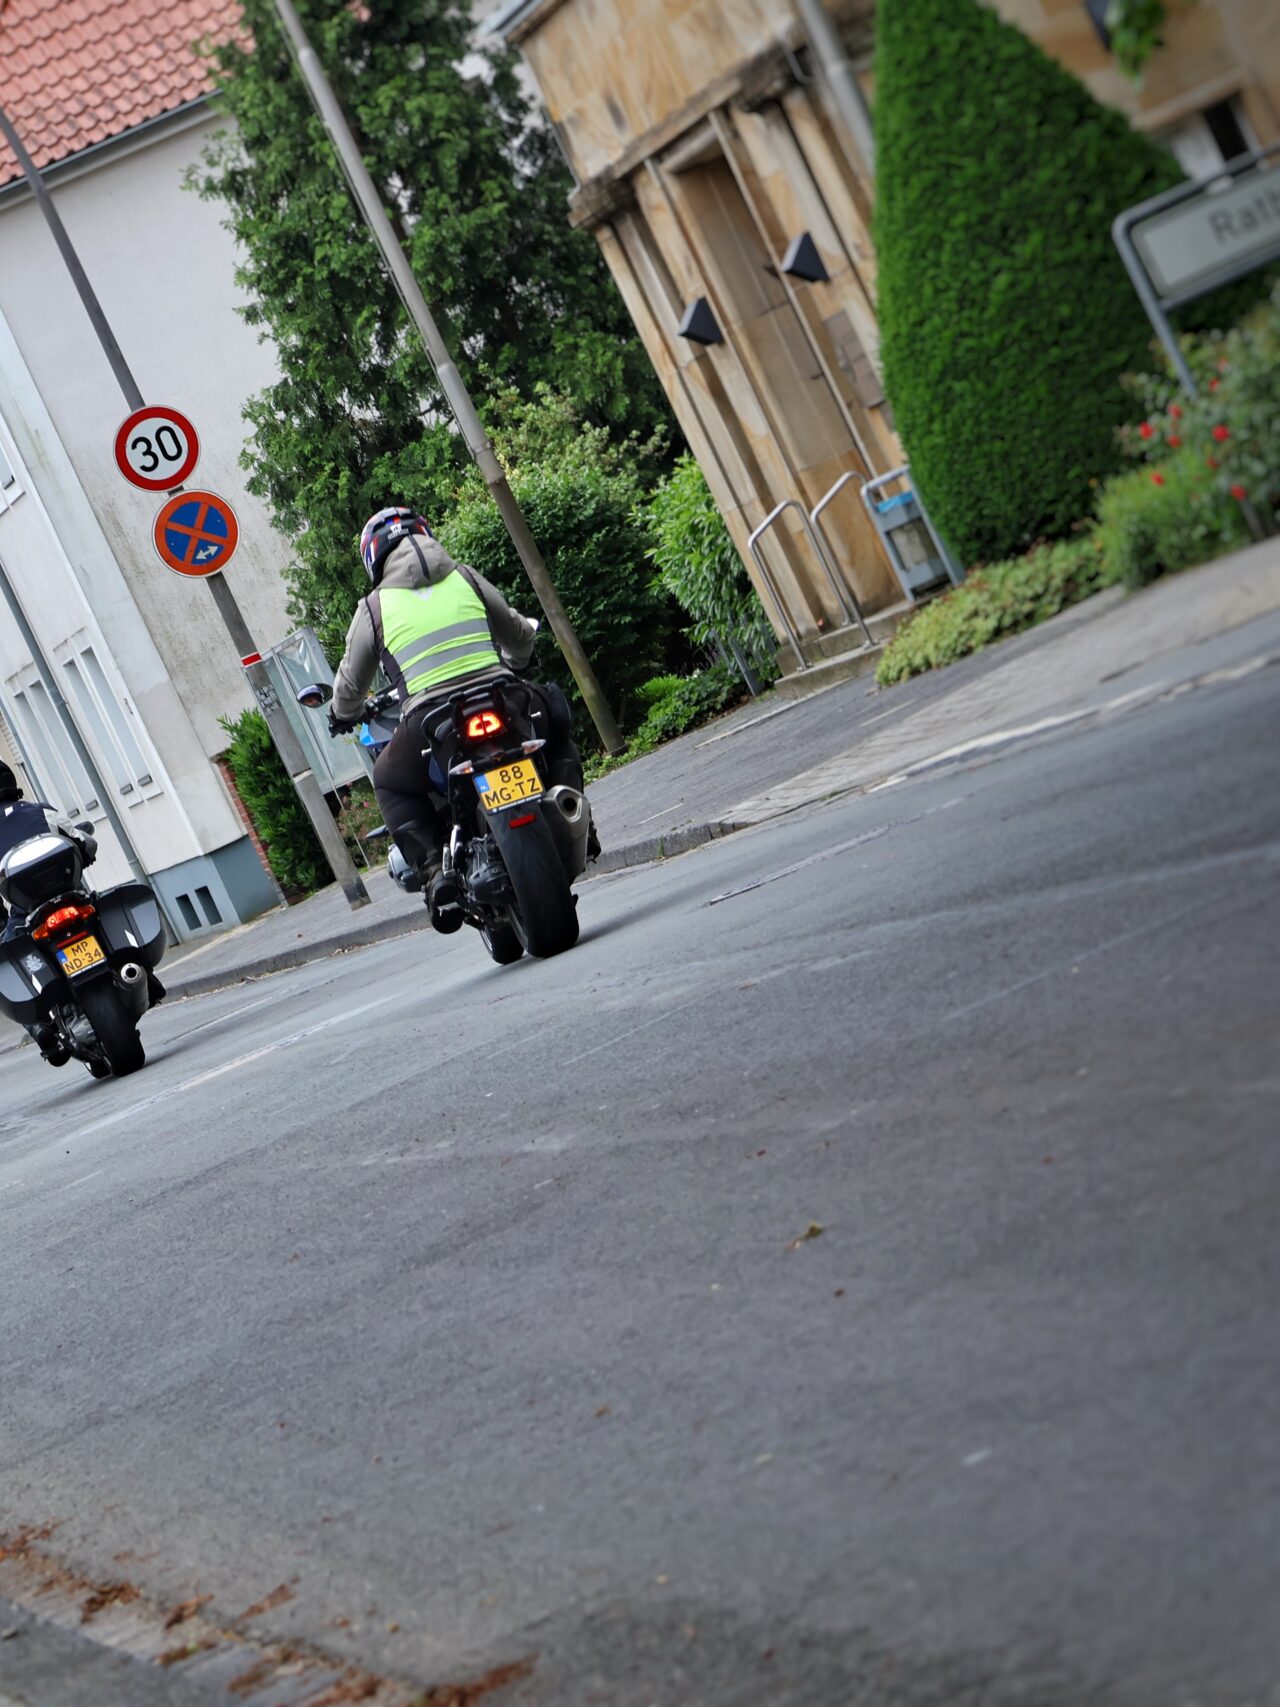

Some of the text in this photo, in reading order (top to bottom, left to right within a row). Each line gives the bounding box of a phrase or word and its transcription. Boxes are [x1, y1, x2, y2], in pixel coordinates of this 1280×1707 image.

[131, 425, 183, 473] 30
[499, 765, 524, 784] 88
[484, 777, 540, 807] MG-TZ
[64, 948, 102, 973] ND-34
[70, 941, 88, 957] MP
